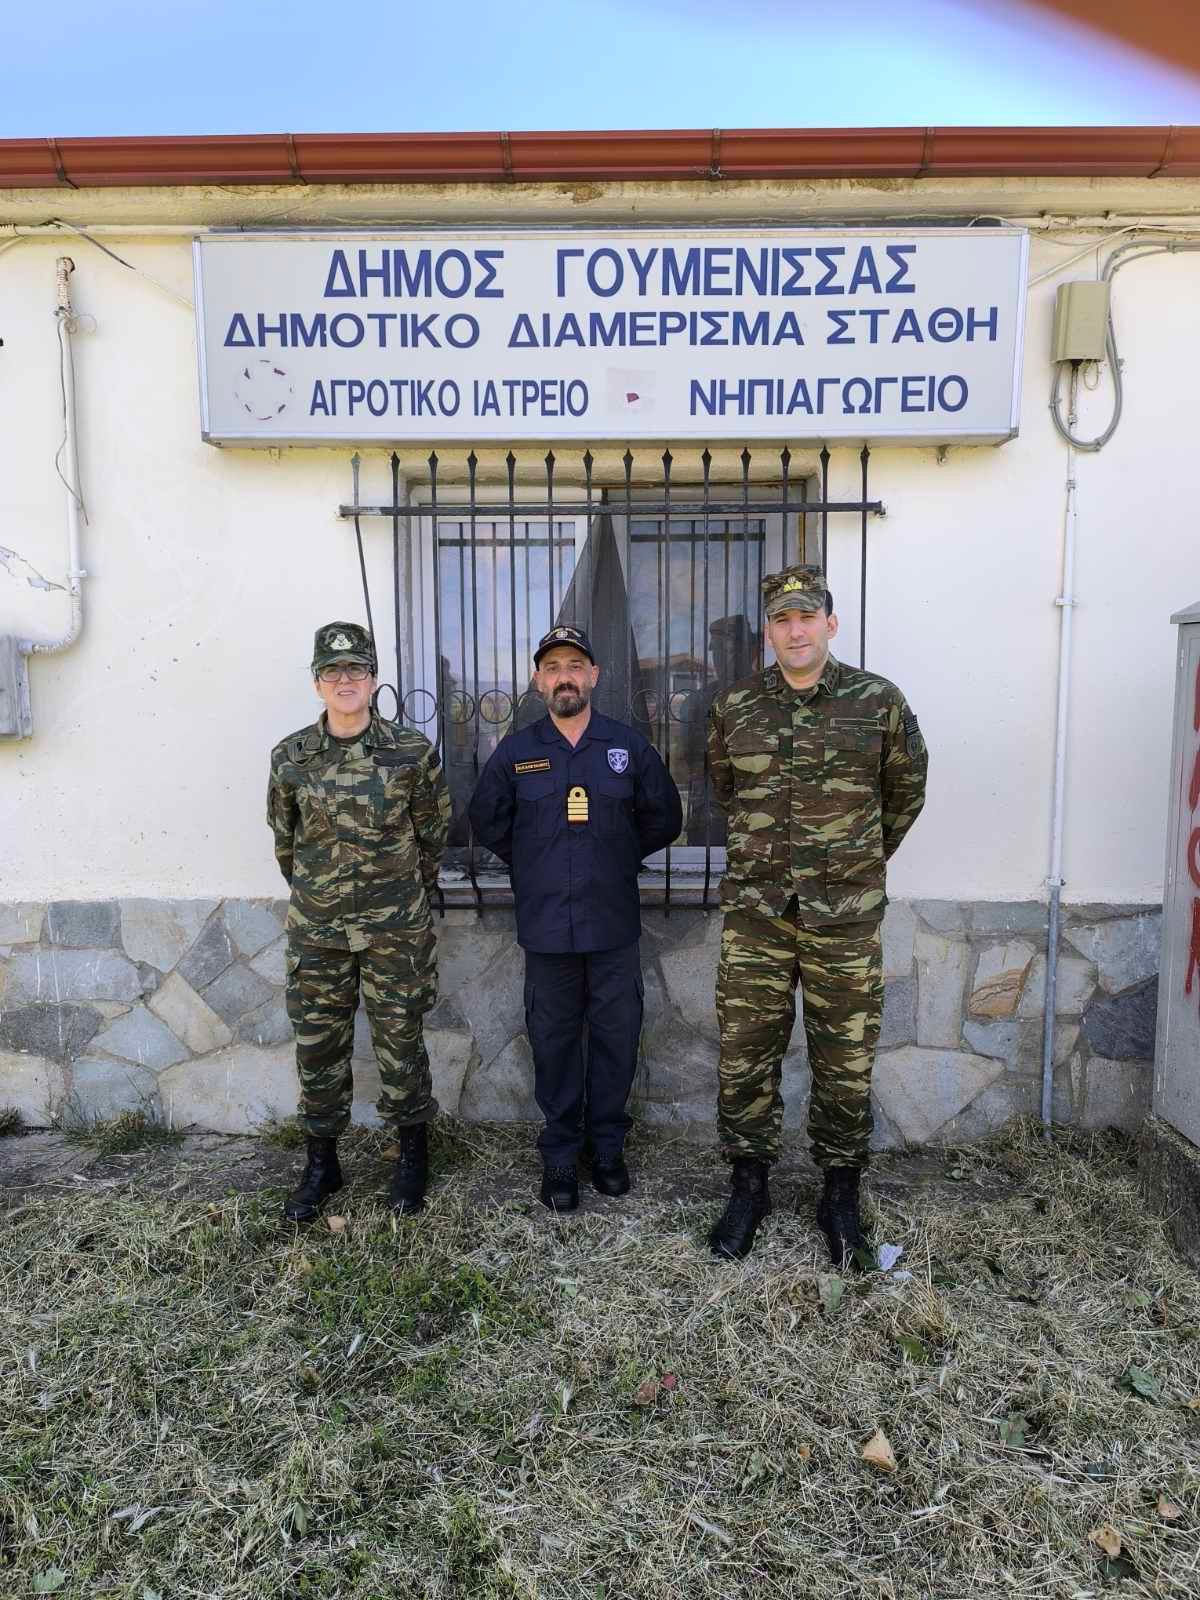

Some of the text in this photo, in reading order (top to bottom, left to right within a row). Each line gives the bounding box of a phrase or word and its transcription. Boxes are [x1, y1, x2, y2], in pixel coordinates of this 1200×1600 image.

[324, 245, 916, 298] ΔΗΜΟΣ ΓΟΥΜΕΝΙΣΣΑΣ
[224, 307, 998, 348] ΔΗΜΟΤΙΚΟ ΔΙΑΜΕΡΙΣΜΑ ΣΤΑΘΗ
[310, 380, 588, 416] ΑΓΡΟΤΙΚΟ ΙΑΤΡΕΙΟ
[690, 375, 968, 415] ΝΗΠΙΑΓΩΓΕΙΟ
